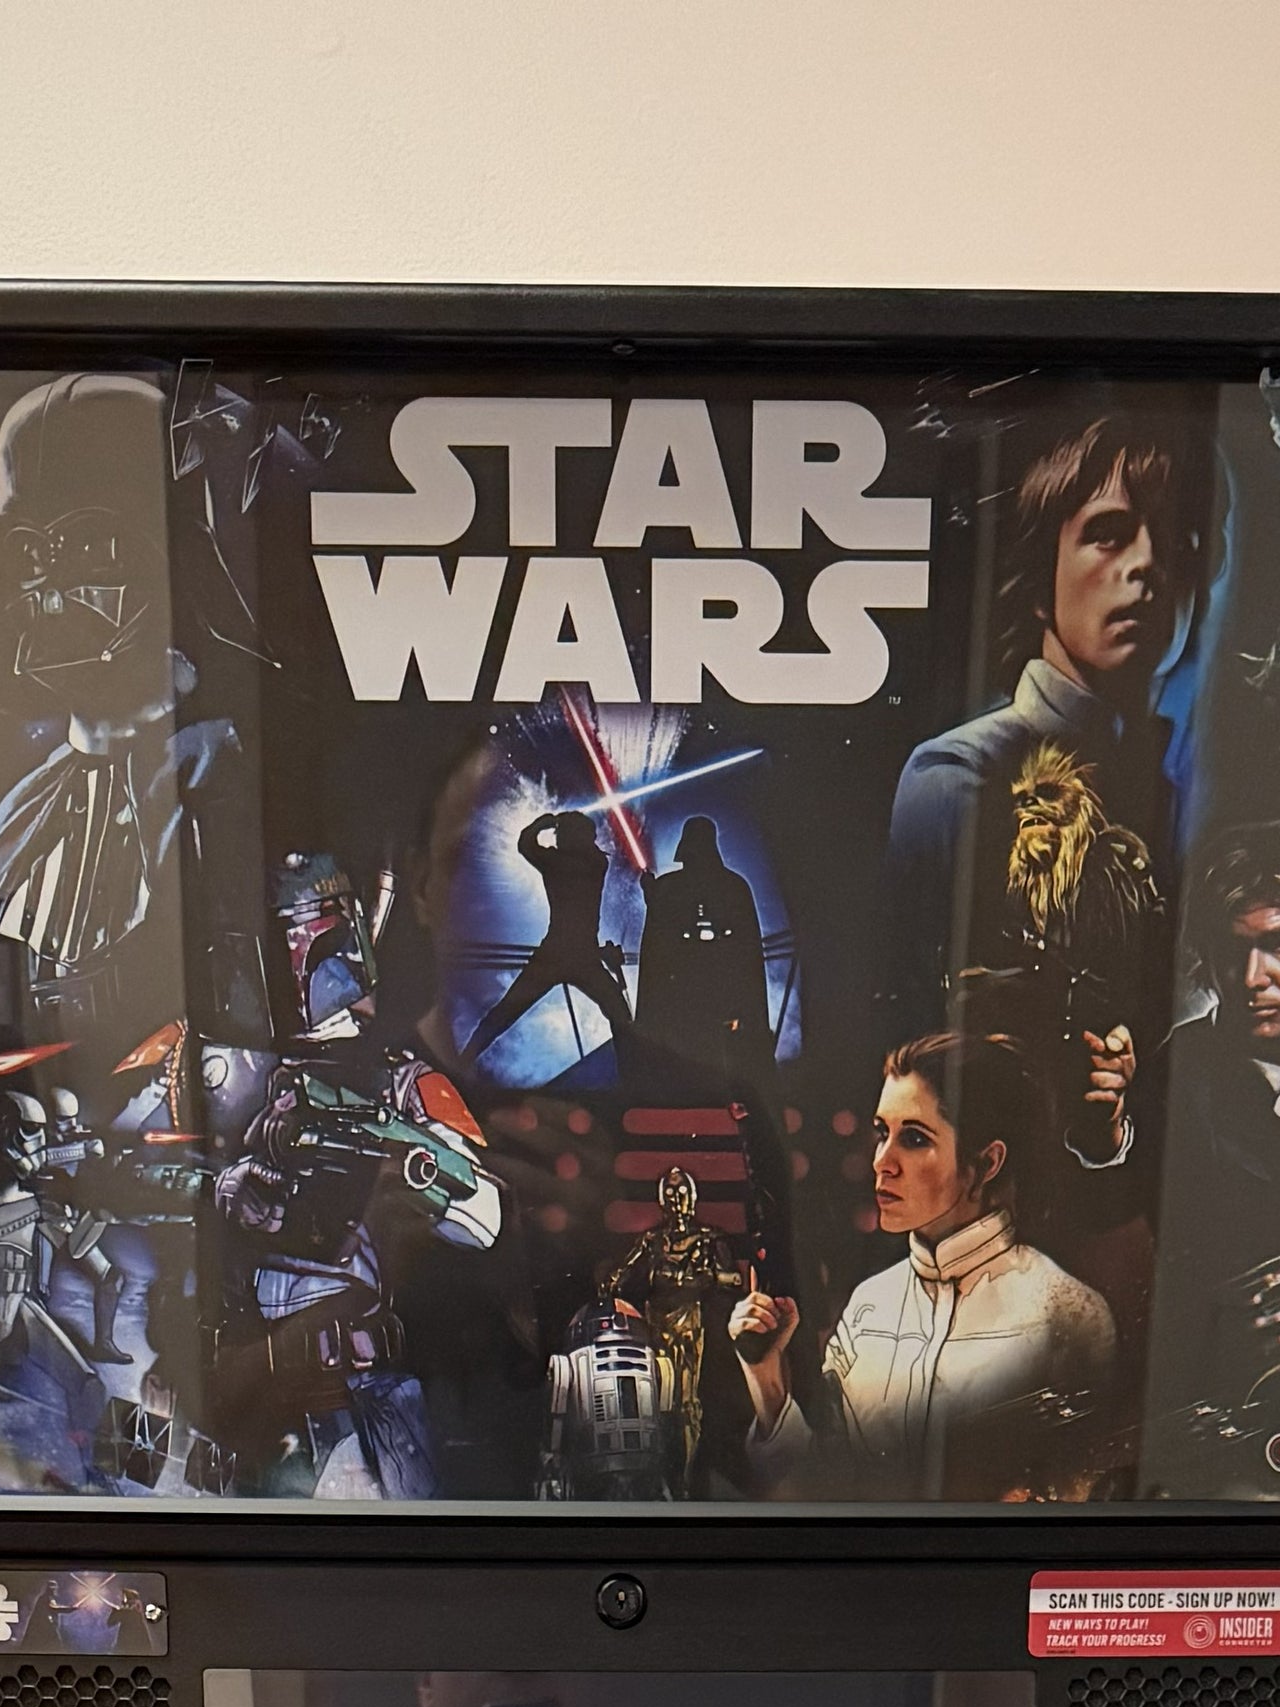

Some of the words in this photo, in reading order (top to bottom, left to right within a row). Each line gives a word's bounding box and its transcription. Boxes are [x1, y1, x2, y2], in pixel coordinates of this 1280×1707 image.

[311, 398, 931, 550] STAR
[312, 556, 930, 704] WARS
[1049, 1593, 1087, 1609] SCAN
[1092, 1593, 1124, 1609] THIS
[1128, 1592, 1165, 1608] CODE
[1176, 1592, 1211, 1608] SIGN
[1214, 1593, 1233, 1608] UP
[1237, 1592, 1275, 1608] NOW!
[1049, 1619, 1072, 1630] NEW
[1074, 1619, 1103, 1630] WAYS
[1106, 1619, 1118, 1630] TO
[1119, 1618, 1149, 1630] PLAY!
[1220, 1617, 1272, 1638] INSIDER
[1047, 1635, 1079, 1646] TRACK
[1081, 1634, 1107, 1646] YOUR
[1109, 1634, 1166, 1646] PROGRESS!
